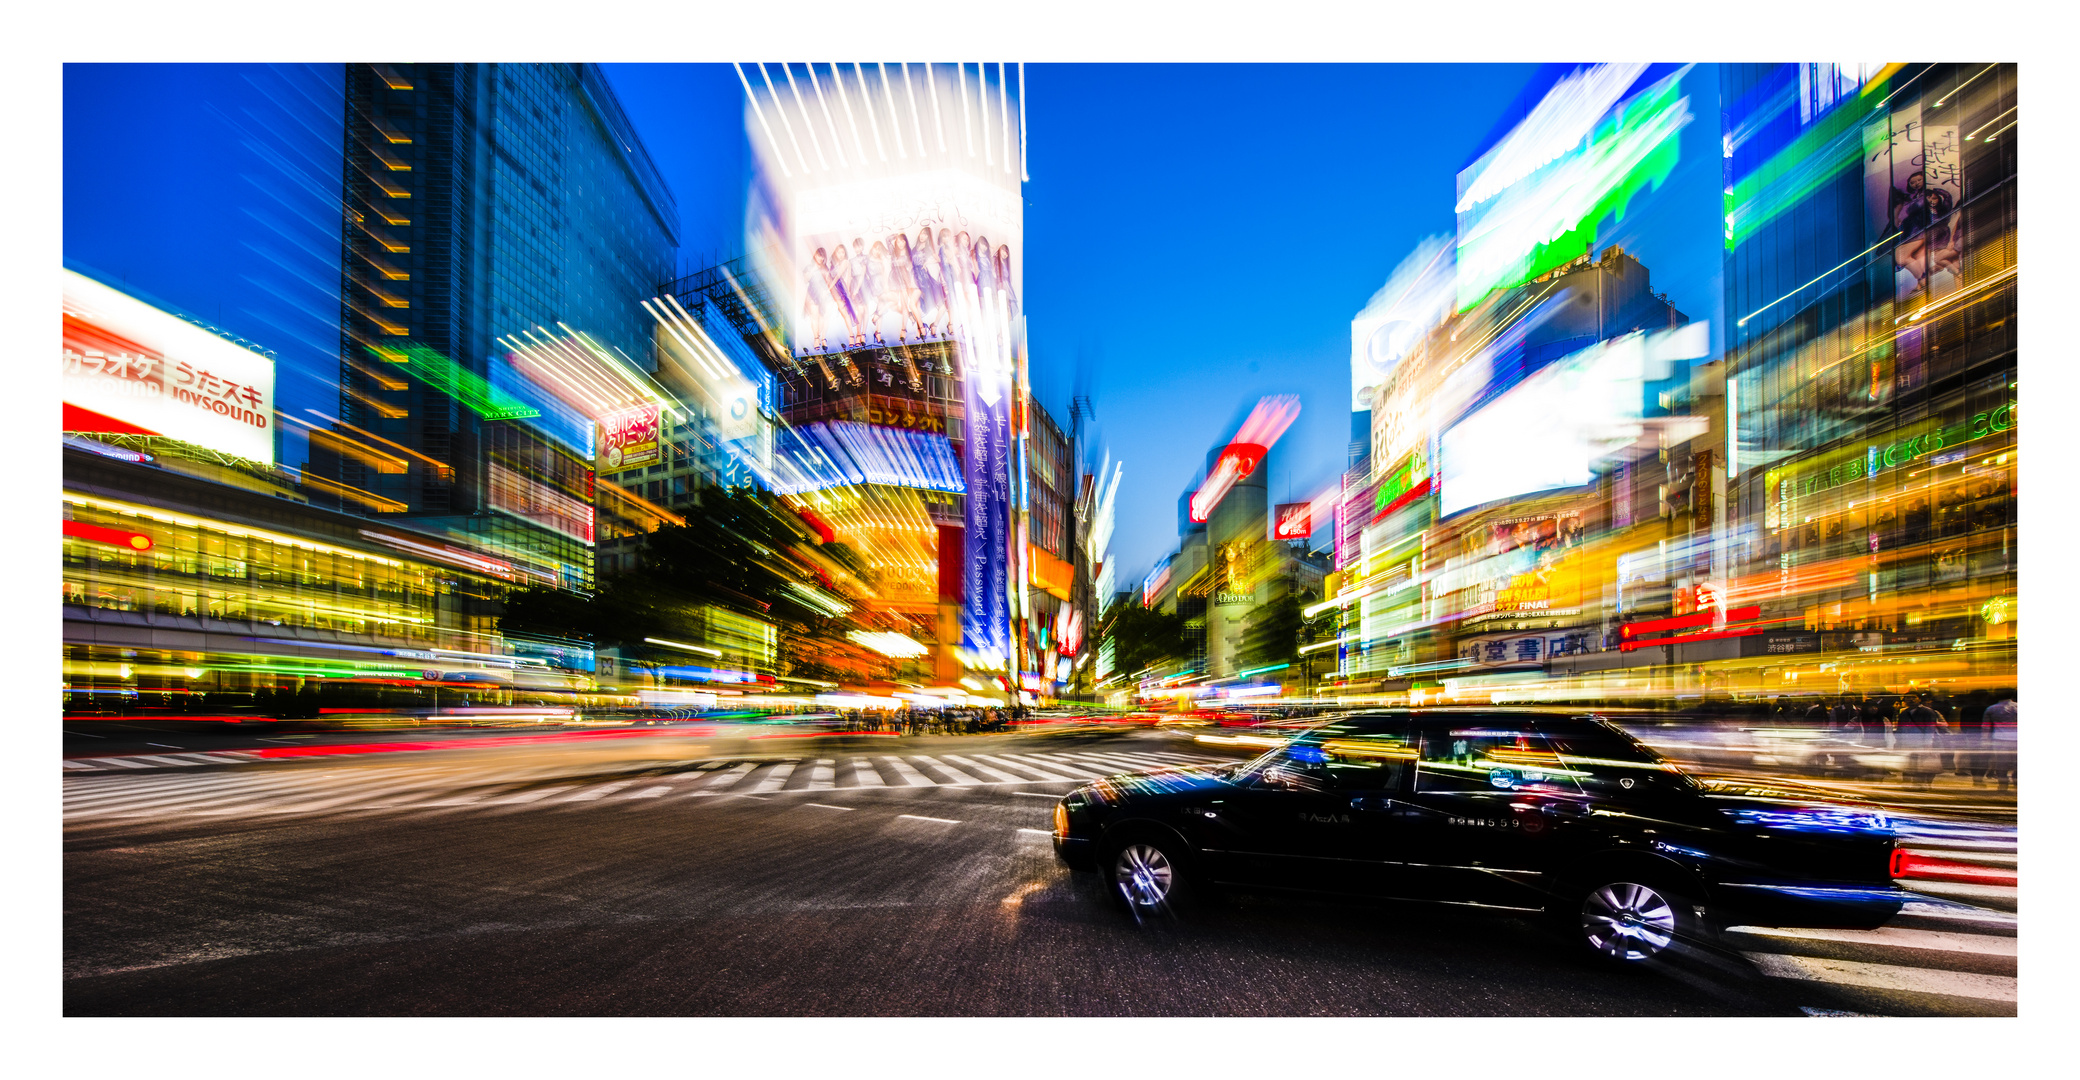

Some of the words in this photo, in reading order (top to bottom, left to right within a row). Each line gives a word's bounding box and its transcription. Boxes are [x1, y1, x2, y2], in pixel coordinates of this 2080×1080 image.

[63, 349, 159, 379] カラオケ
[176, 361, 264, 411] うたスキ
[171, 386, 267, 429] JOYSOUND
[516, 409, 540, 417] CITY
[606, 411, 658, 436] 品川スキン
[607, 426, 658, 451] クリニック
[1511, 575, 1536, 588] NOW
[1497, 589, 1513, 603] ON
[1496, 602, 1519, 612] 9.27
[1519, 601, 1549, 610] FINAL
[1487, 819, 1520, 828] 559
